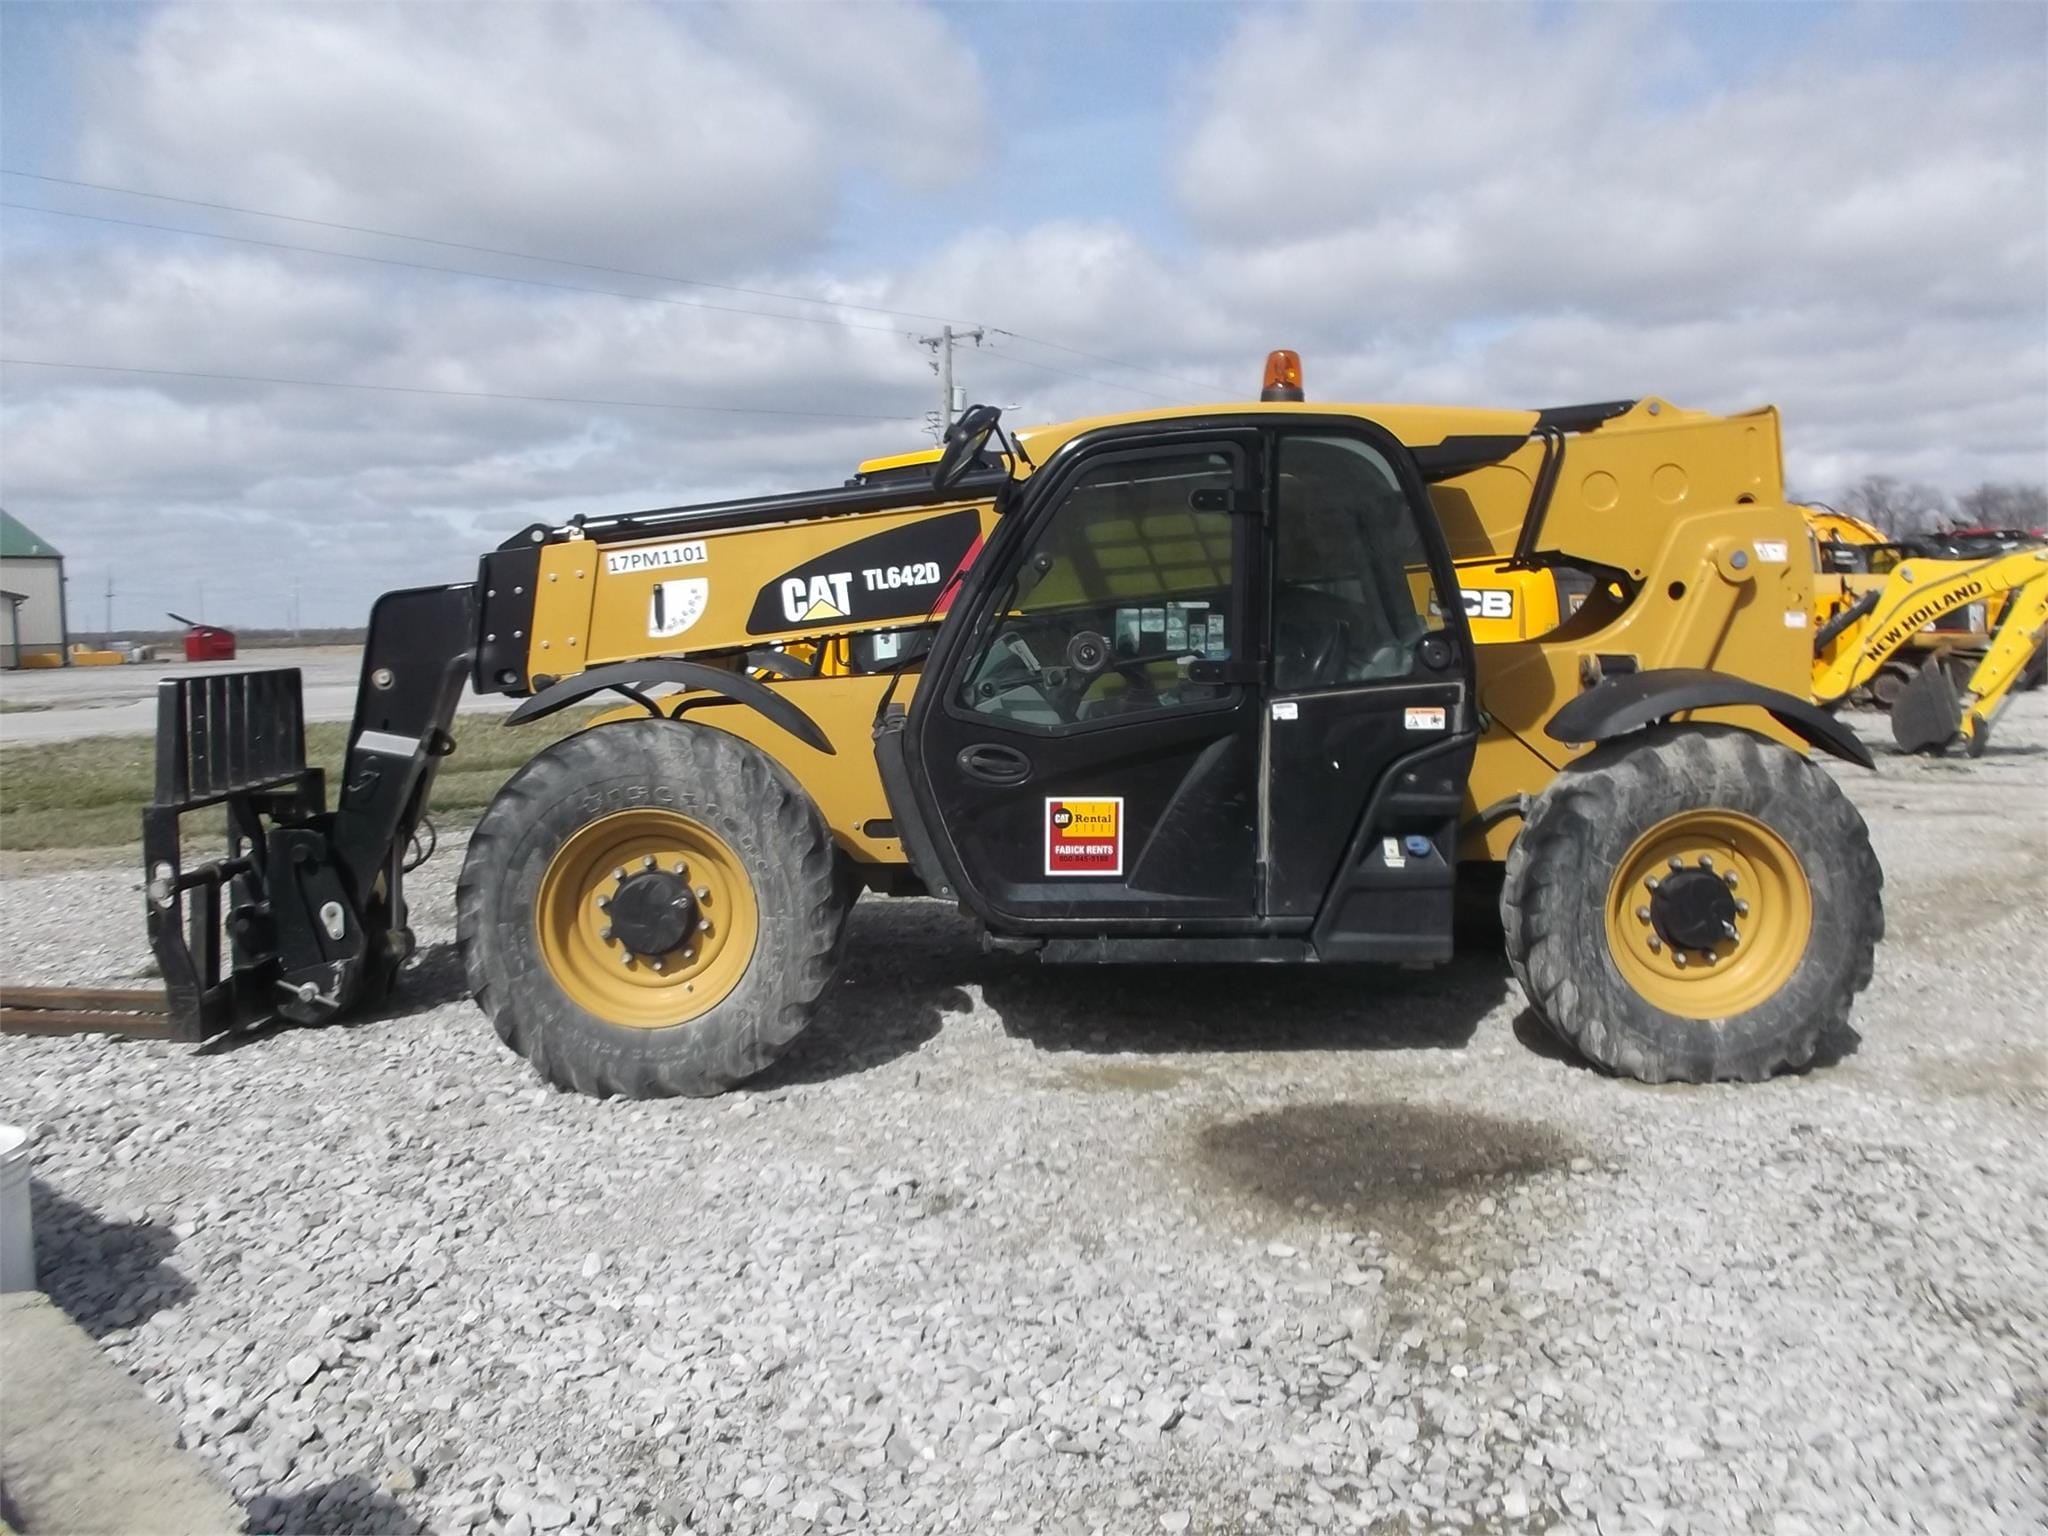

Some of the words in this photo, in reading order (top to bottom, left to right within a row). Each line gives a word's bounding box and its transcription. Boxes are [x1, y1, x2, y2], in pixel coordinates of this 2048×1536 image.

[609, 546, 705, 572] 17PM1101
[781, 572, 853, 622] CAT
[862, 562, 941, 592] TL642D
[1866, 627, 1903, 662] NEW
[1901, 580, 1983, 631] HOLLAND
[1054, 813, 1070, 824] CAT
[1074, 813, 1112, 823] Rental
[1055, 845, 1085, 855] FABICK
[1086, 845, 1114, 855] RENTS
